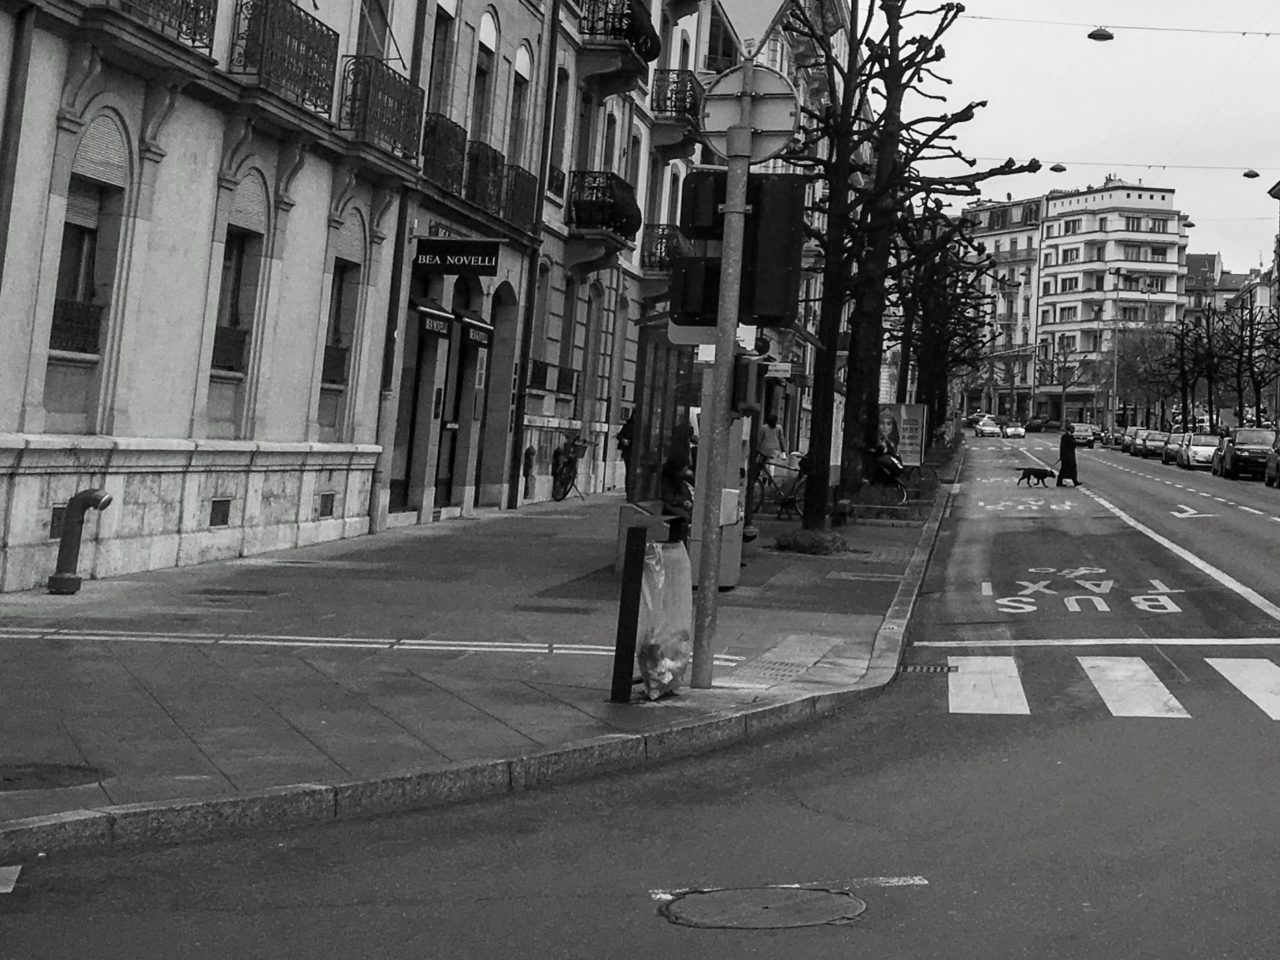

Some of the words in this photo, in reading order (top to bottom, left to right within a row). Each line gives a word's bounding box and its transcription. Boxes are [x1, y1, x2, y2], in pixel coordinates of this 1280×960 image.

[418, 255, 441, 265] BEA
[446, 256, 496, 266] NOVELLI
[981, 579, 1185, 596] TAXI
[995, 595, 1183, 613] BUS
